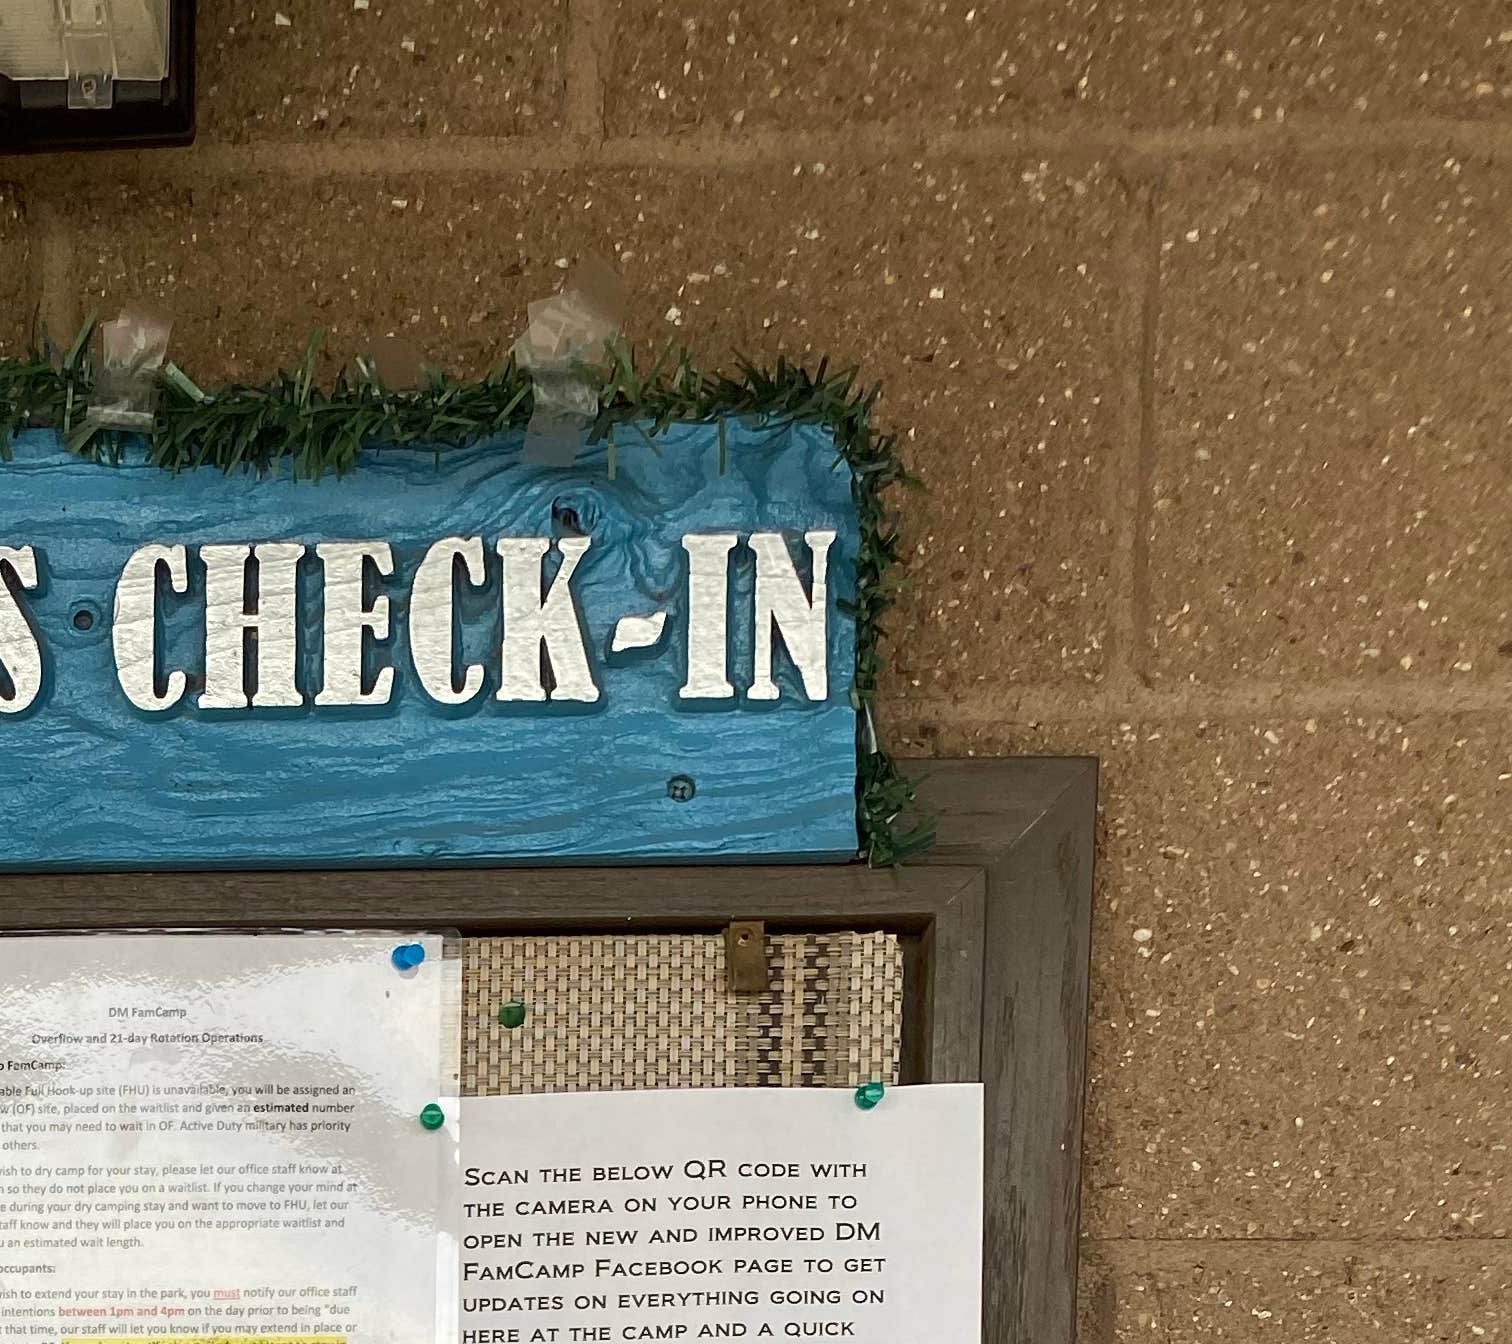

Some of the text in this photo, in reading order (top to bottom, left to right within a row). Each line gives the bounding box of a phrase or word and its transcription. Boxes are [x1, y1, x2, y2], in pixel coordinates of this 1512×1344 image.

[112, 531, 838, 711] CHECK-IN
[464, 1161, 866, 1186] SCAN THE BELOW QR CODE WITH
[734, 1258, 792, 1273] PAGE
[803, 1258, 833, 1273] TO
[844, 1257, 886, 1272] GET
